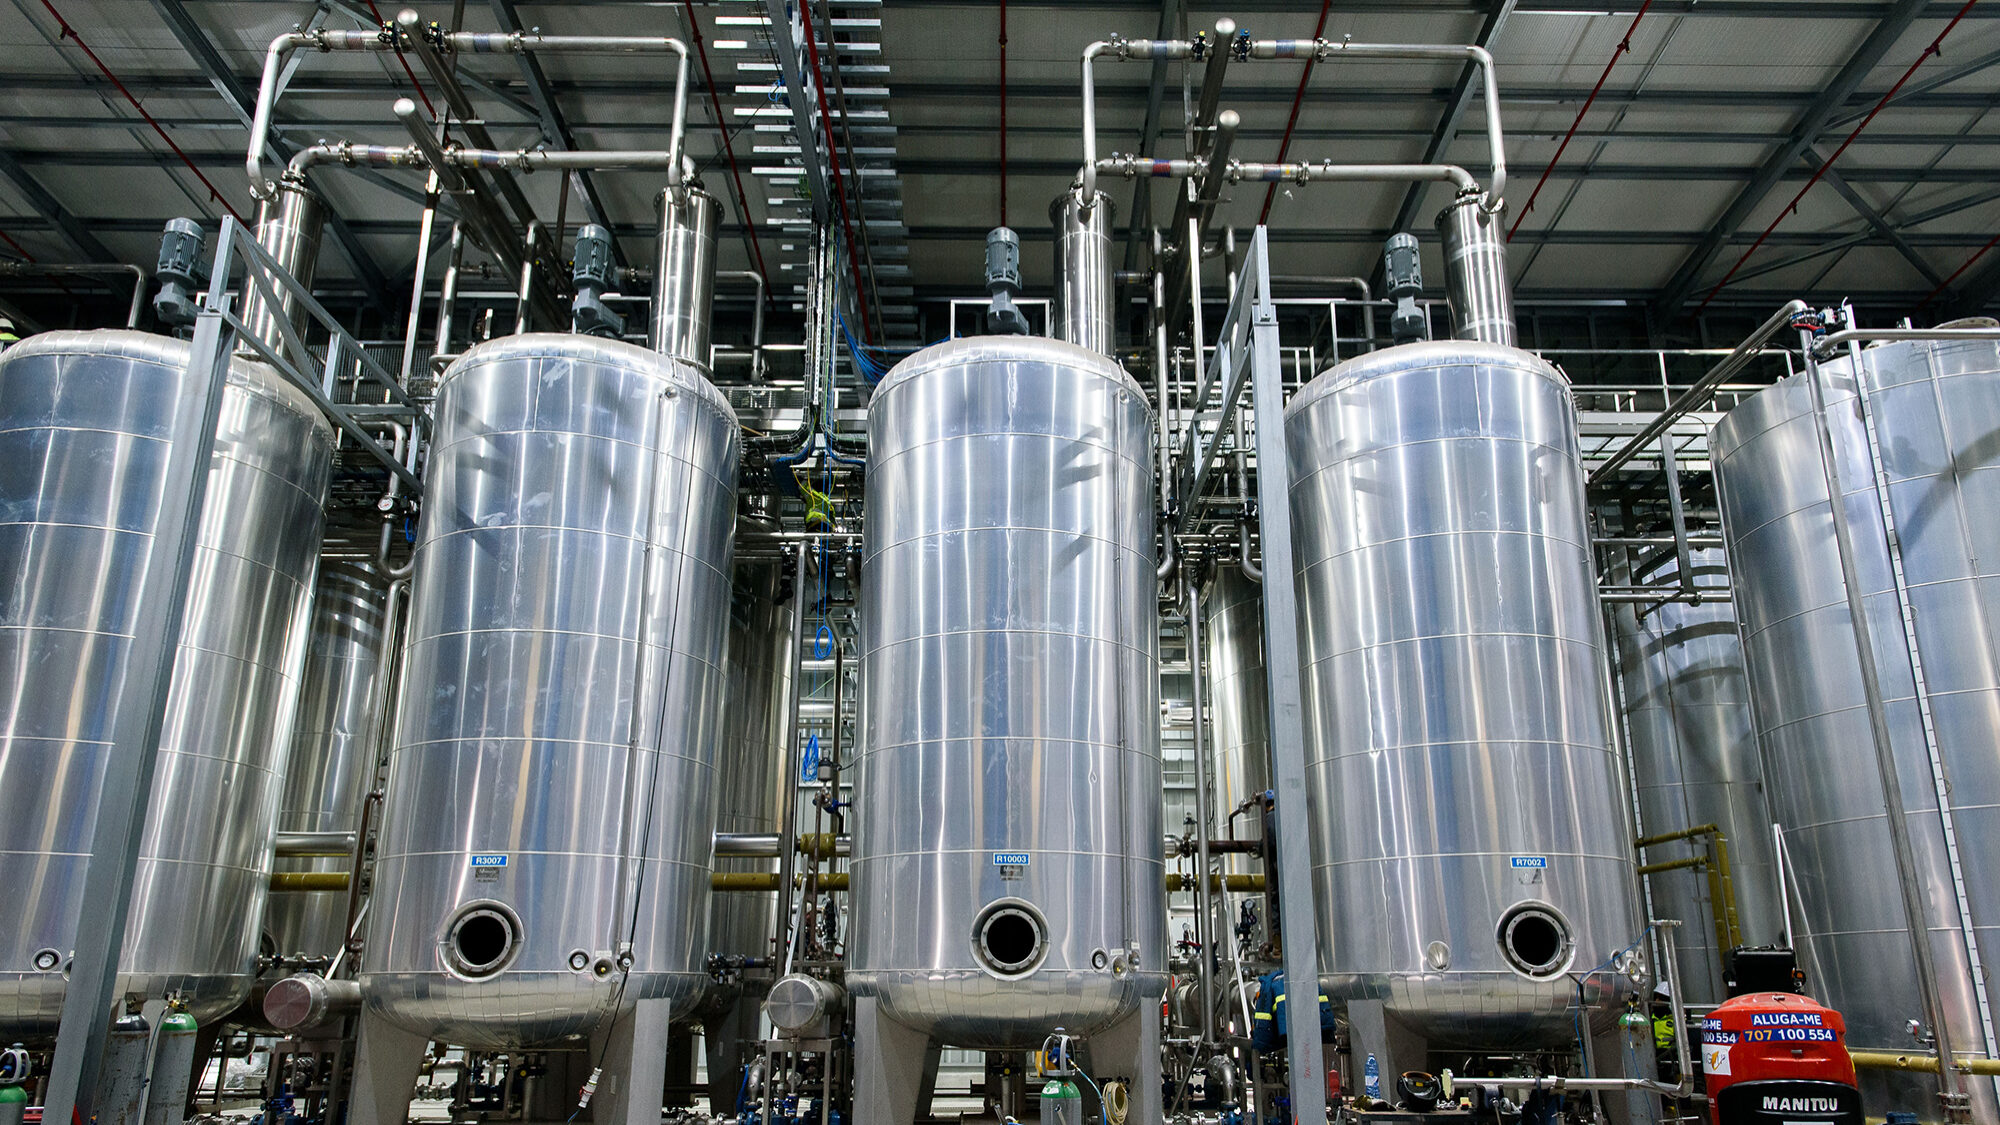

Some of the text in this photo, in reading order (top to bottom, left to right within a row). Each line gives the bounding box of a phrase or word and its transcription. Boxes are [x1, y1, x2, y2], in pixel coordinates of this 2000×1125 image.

[476, 856, 502, 865] R3007
[996, 855, 1027, 863] R10003
[1516, 858, 1542, 866] R7002
[1753, 1013, 1822, 1026] ALUGA-ME
[1716, 1032, 1736, 1043] 554
[1745, 1029, 1833, 1041] 707 100 554
[1763, 1096, 1838, 1111] MANITOU
